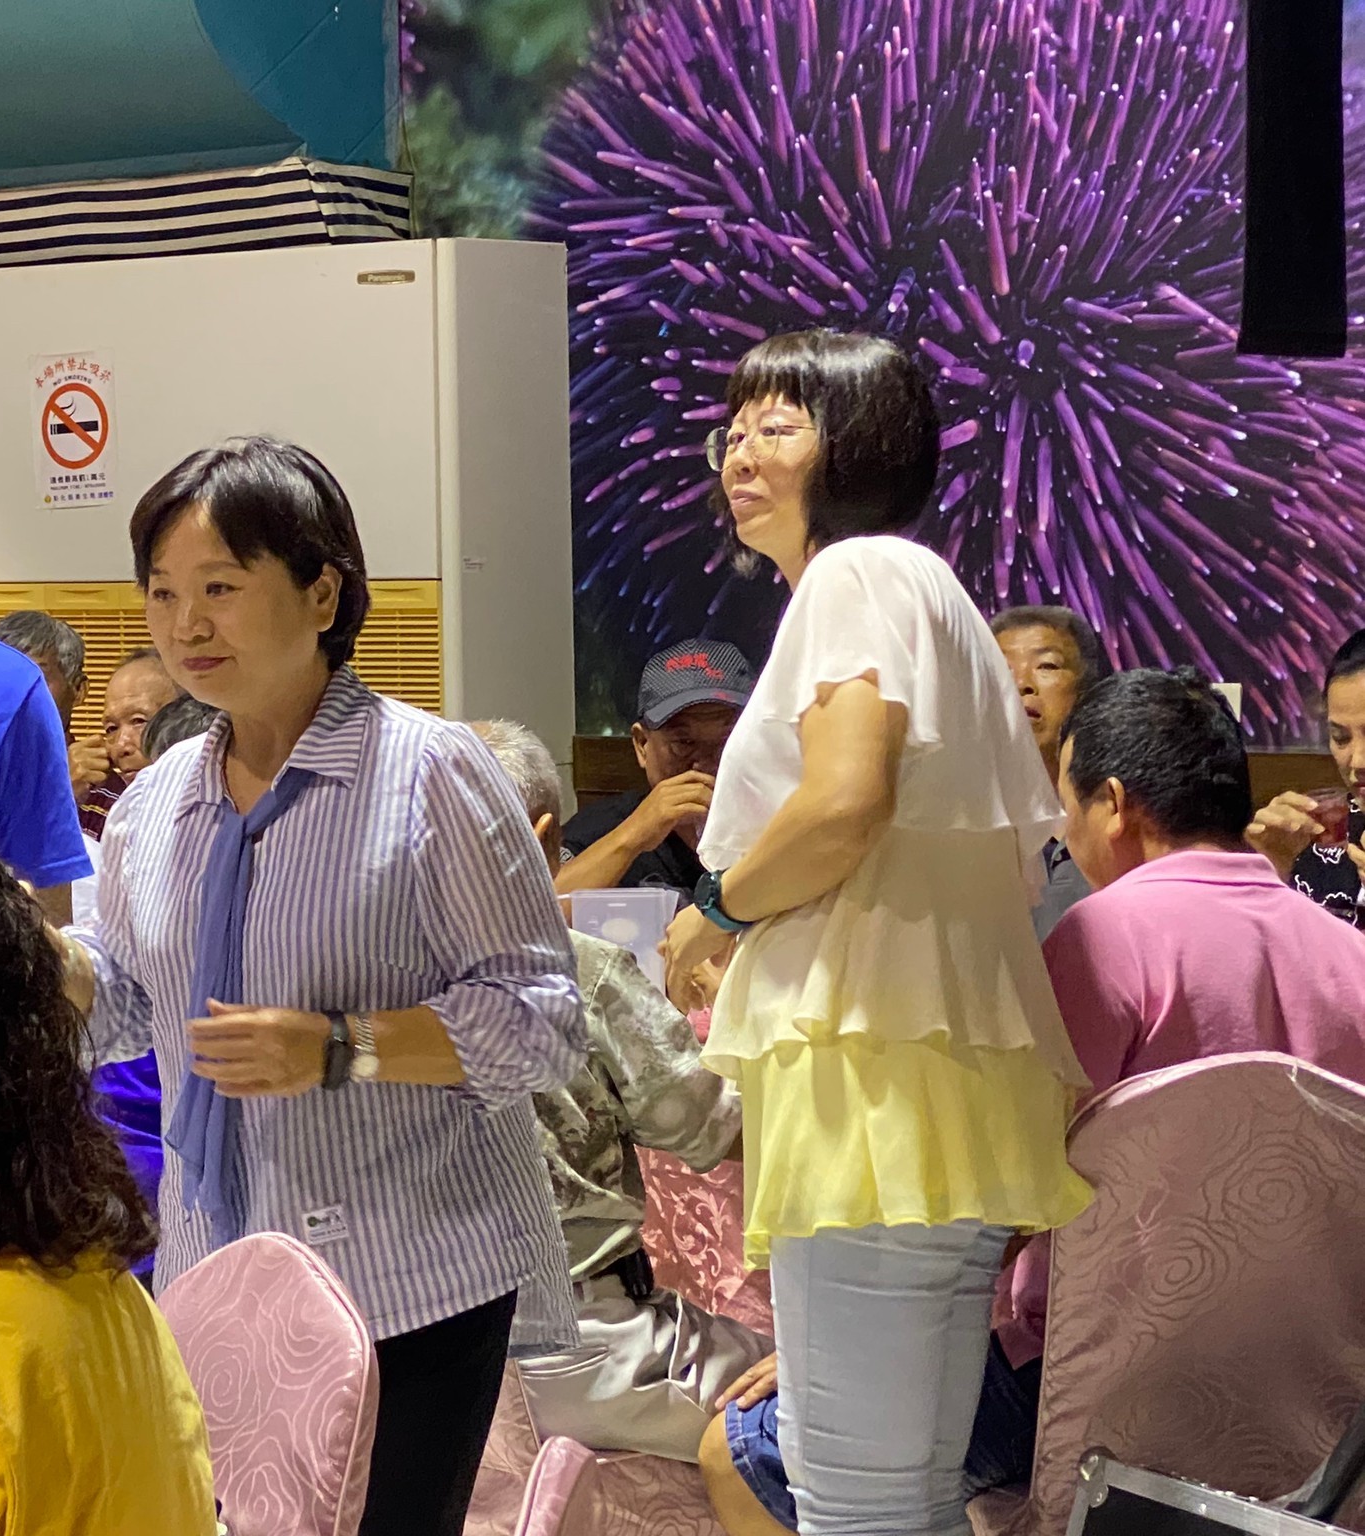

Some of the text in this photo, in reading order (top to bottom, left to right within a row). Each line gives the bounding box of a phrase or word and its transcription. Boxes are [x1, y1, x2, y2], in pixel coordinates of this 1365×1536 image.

[35, 356, 111, 388] 本場所禁止吸菸
[53, 374, 92, 386] NO SMOKING
